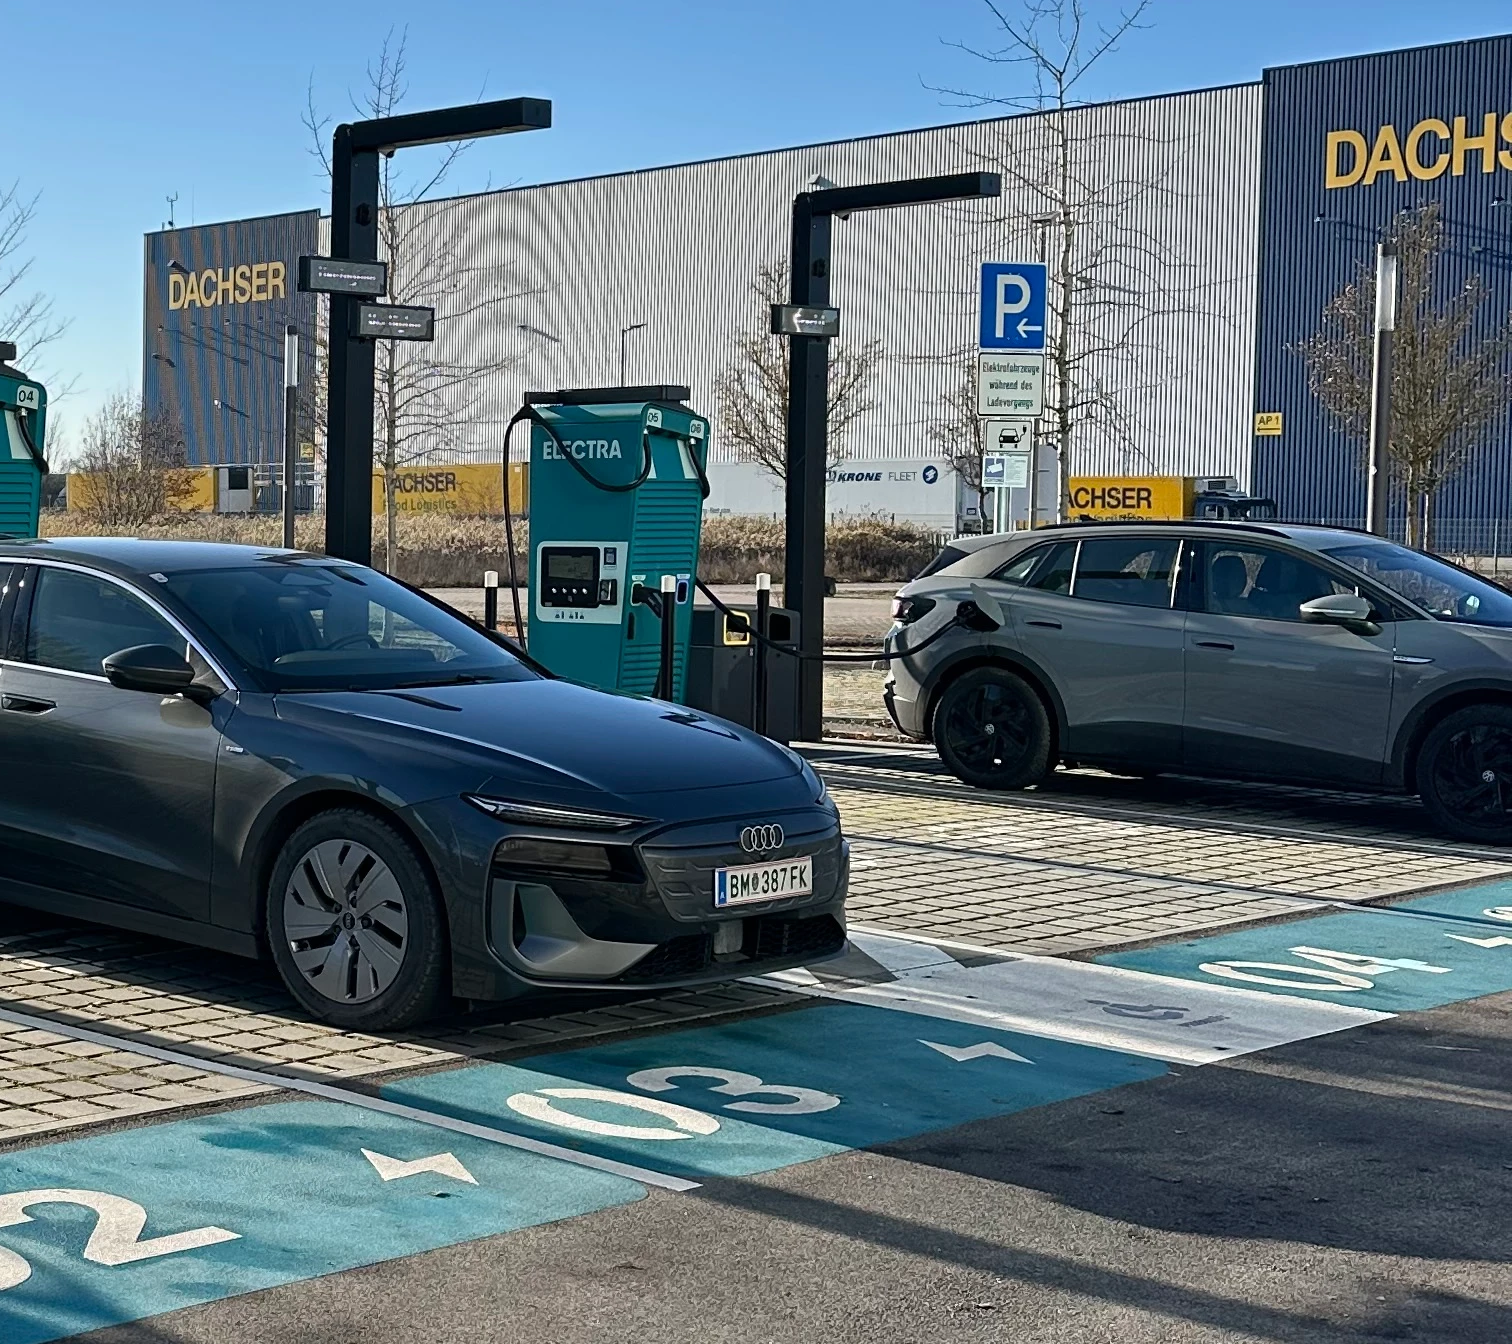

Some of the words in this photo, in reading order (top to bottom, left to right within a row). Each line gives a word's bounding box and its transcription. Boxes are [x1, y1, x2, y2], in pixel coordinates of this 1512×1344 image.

[1326, 112, 1512, 189] DACH
[169, 261, 285, 310] DACHSER
[996, 274, 1031, 338] P
[18, 390, 34, 403] 04
[1020, 380, 1033, 390] des
[1258, 415, 1272, 425] AP
[837, 472, 883, 482] KRONE
[888, 471, 917, 481] FLEET
[730, 873, 750, 898] BM
[1199, 946, 1453, 991] 04
[506, 1066, 841, 1140] 03
